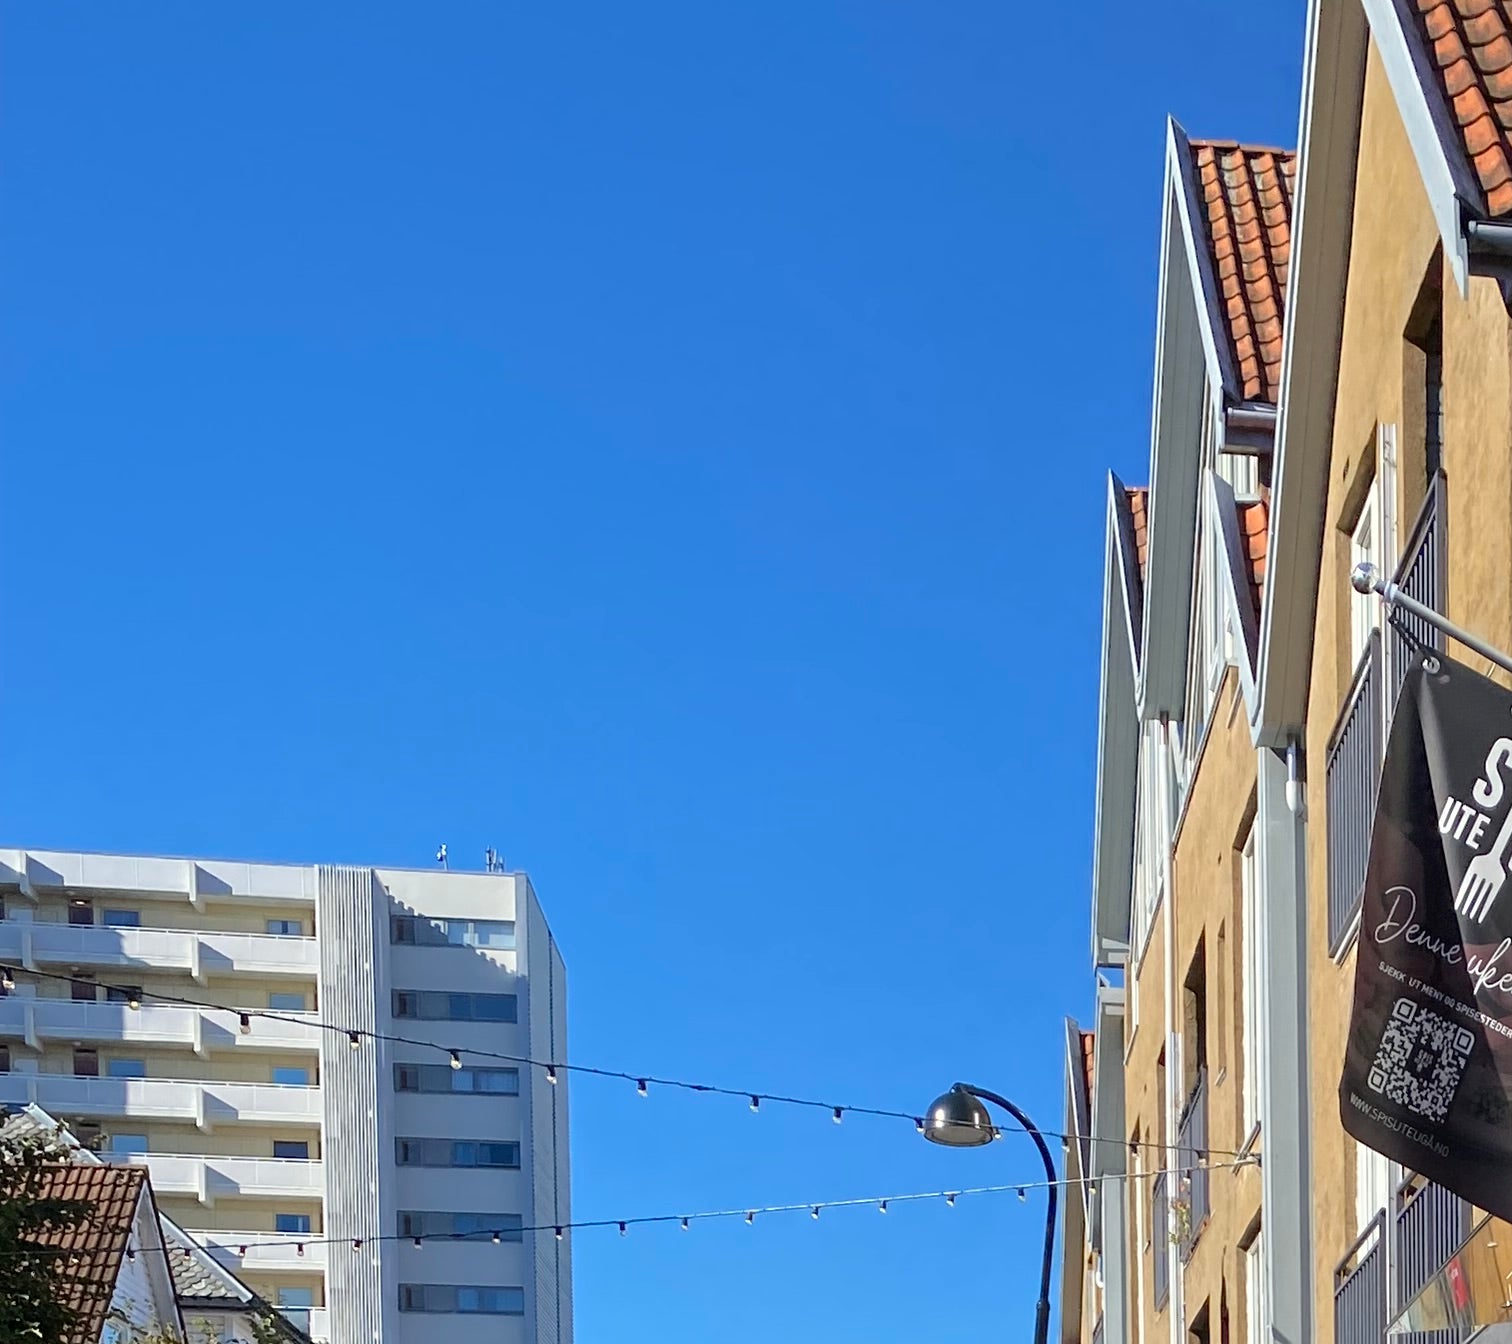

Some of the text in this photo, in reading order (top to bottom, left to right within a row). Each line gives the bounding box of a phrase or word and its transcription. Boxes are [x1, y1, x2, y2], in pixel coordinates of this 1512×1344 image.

[1438, 796, 1491, 850] UTE
[1375, 886, 1462, 964] Denne
[1378, 961, 1406, 983] SJEKK
[1408, 977, 1421, 990] UT
[1422, 982, 1444, 1002] MENY
